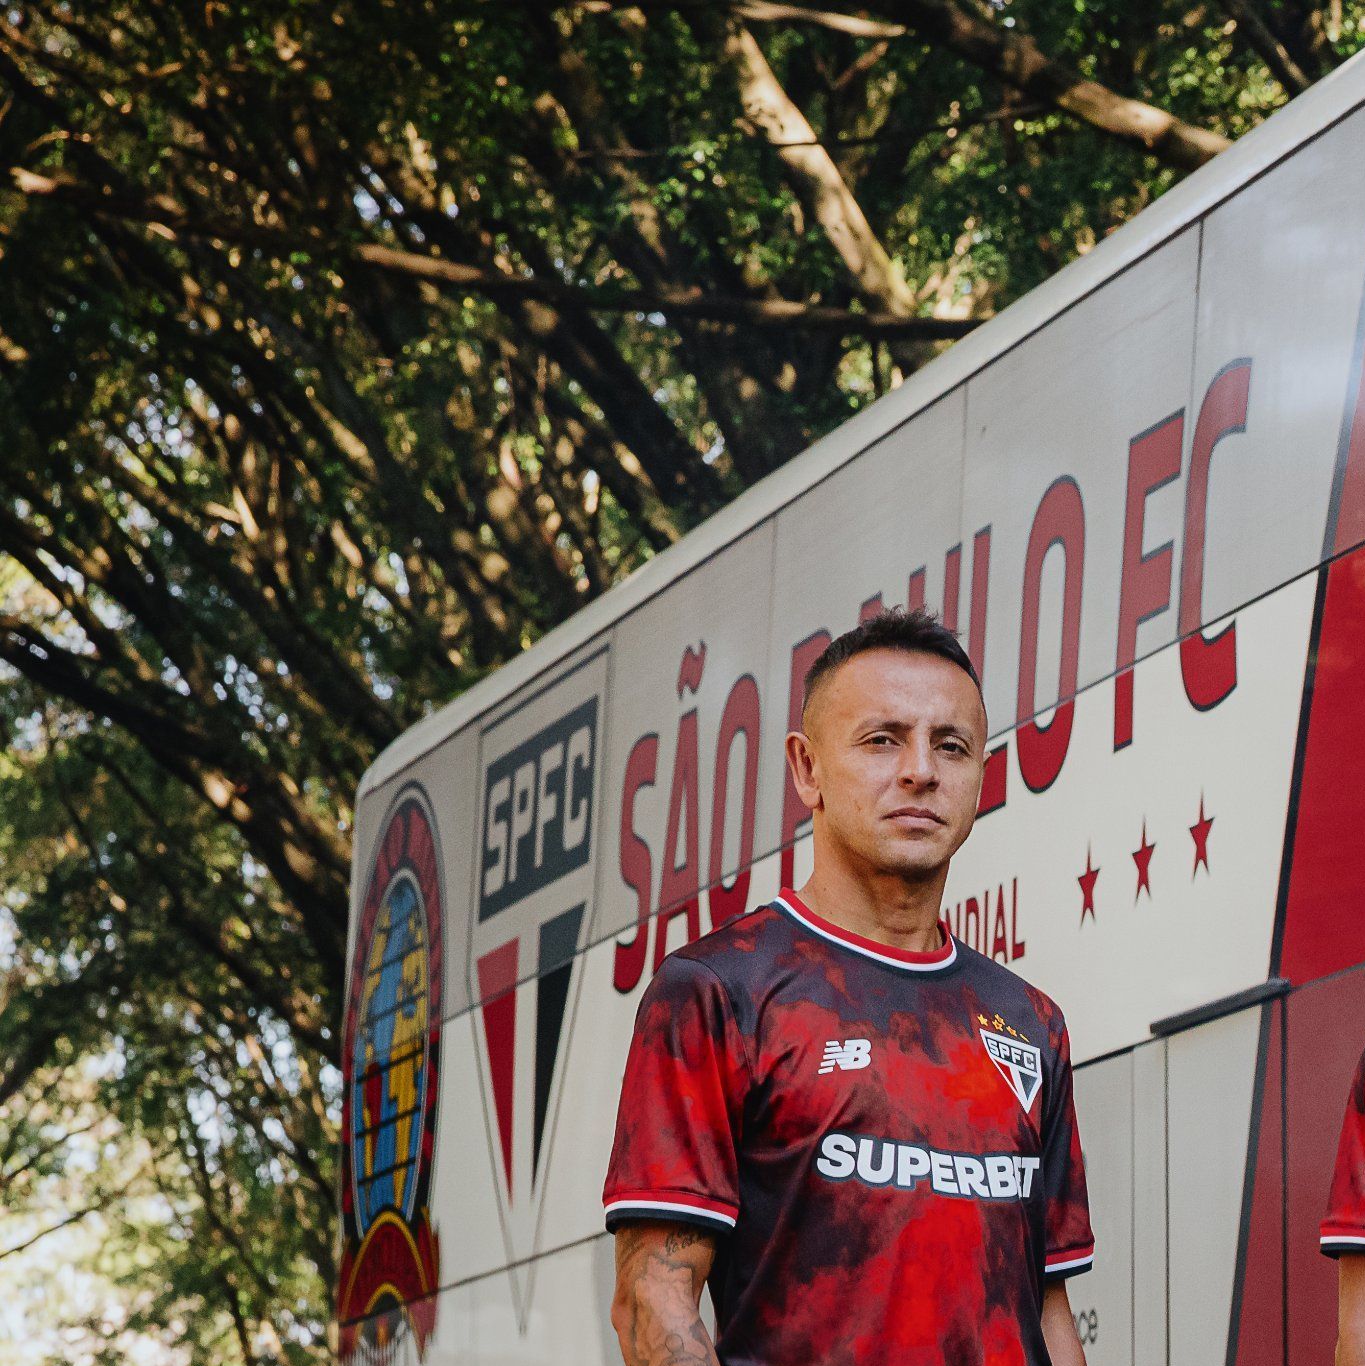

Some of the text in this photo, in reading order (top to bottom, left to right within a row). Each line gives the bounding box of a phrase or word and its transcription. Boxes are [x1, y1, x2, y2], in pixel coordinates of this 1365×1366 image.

[612, 640, 761, 995] SÃO
[1111, 356, 1254, 754] FC
[484, 723, 592, 899] SPFC
[987, 1038, 1036, 1070] SPFC
